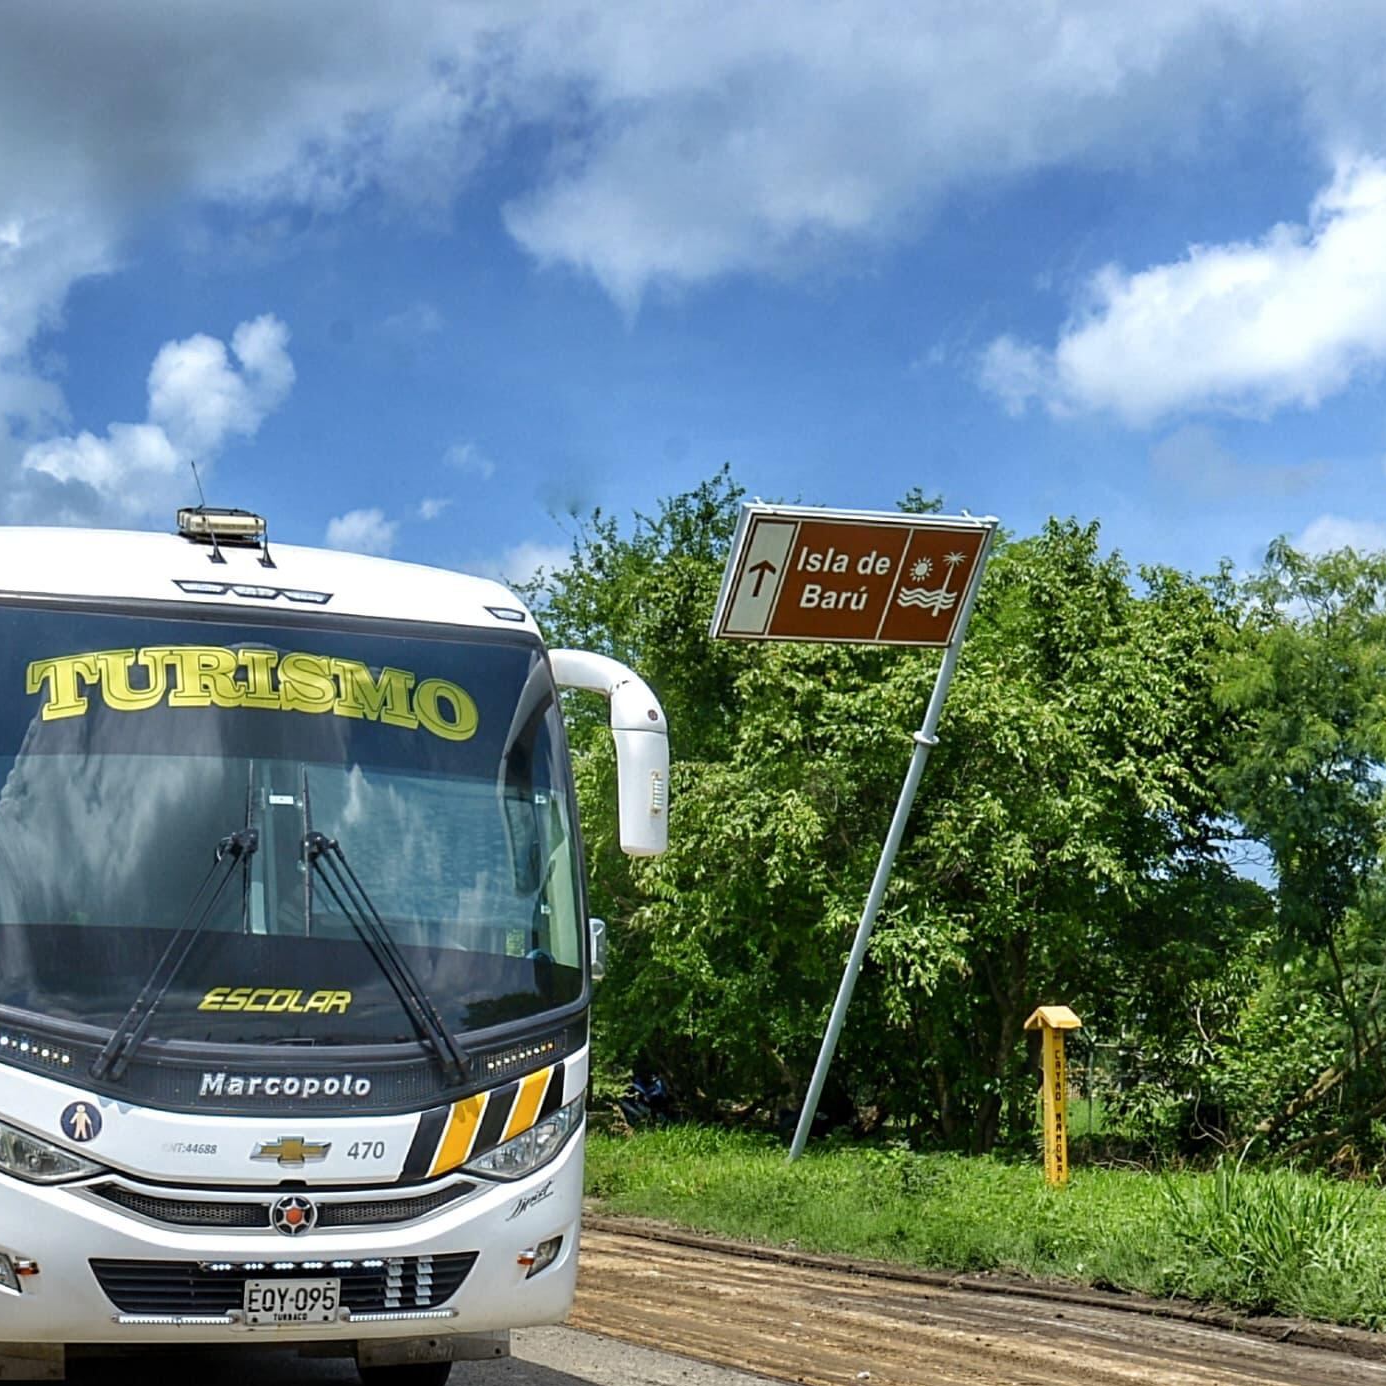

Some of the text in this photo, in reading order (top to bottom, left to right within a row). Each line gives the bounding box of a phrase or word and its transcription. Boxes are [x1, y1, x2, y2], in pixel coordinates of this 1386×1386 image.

[797, 546, 891, 576] Isla de
[799, 584, 869, 611] Barú
[25, 644, 480, 741] TURISMO
[197, 986, 352, 1014] ESCOLAR
[199, 1071, 371, 1097] Marcopolo
[347, 1141, 385, 1160] 470
